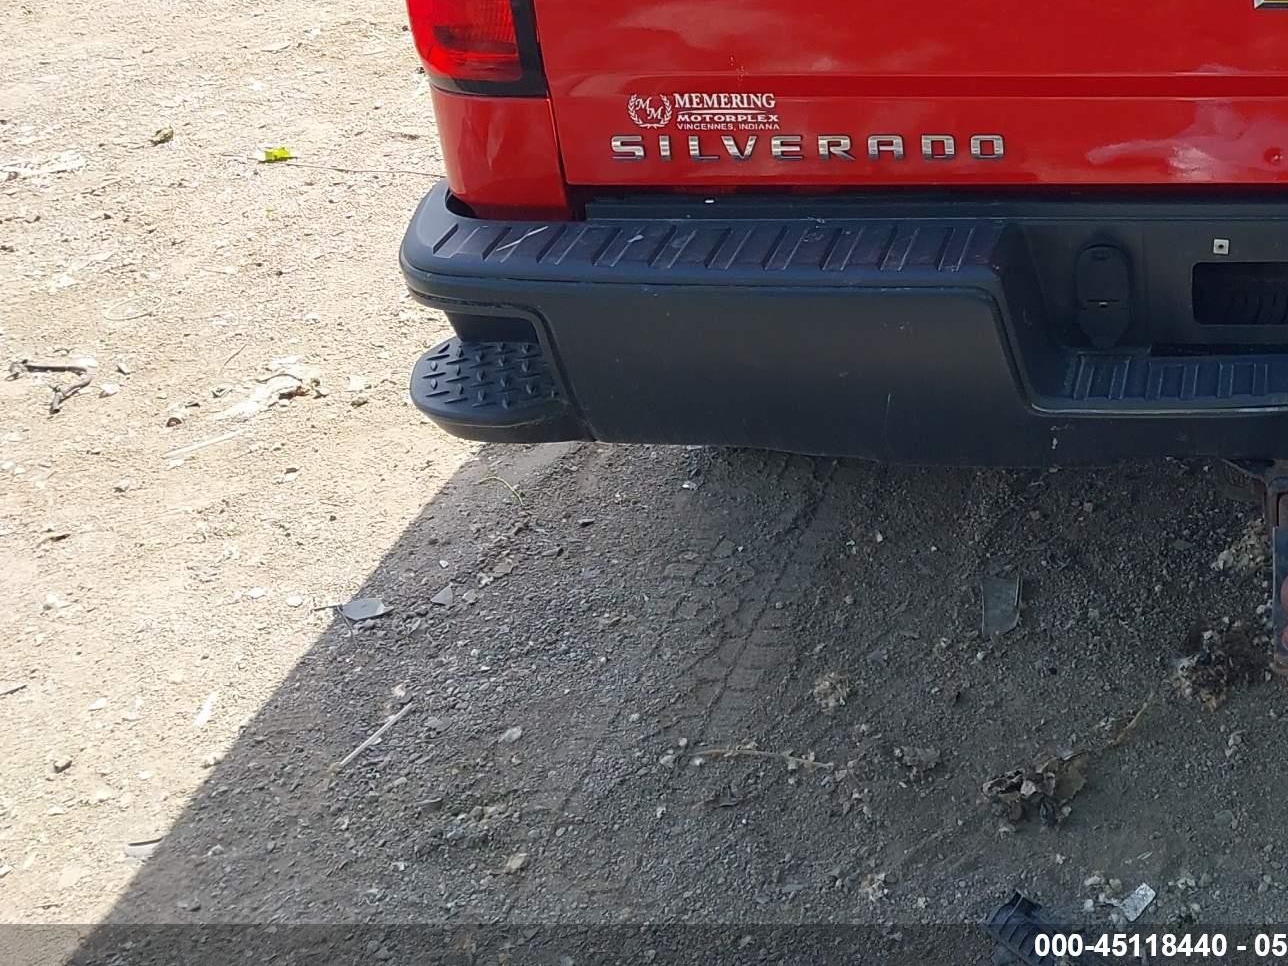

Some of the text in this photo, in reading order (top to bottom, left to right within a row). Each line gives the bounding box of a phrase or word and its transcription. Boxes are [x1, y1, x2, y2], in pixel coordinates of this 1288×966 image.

[673, 93, 776, 109] MEMERING
[676, 114, 780, 123] MOTORPLEX
[676, 123, 780, 132] VINCENNES, INDIANA
[610, 134, 1007, 163] SILVERADO
